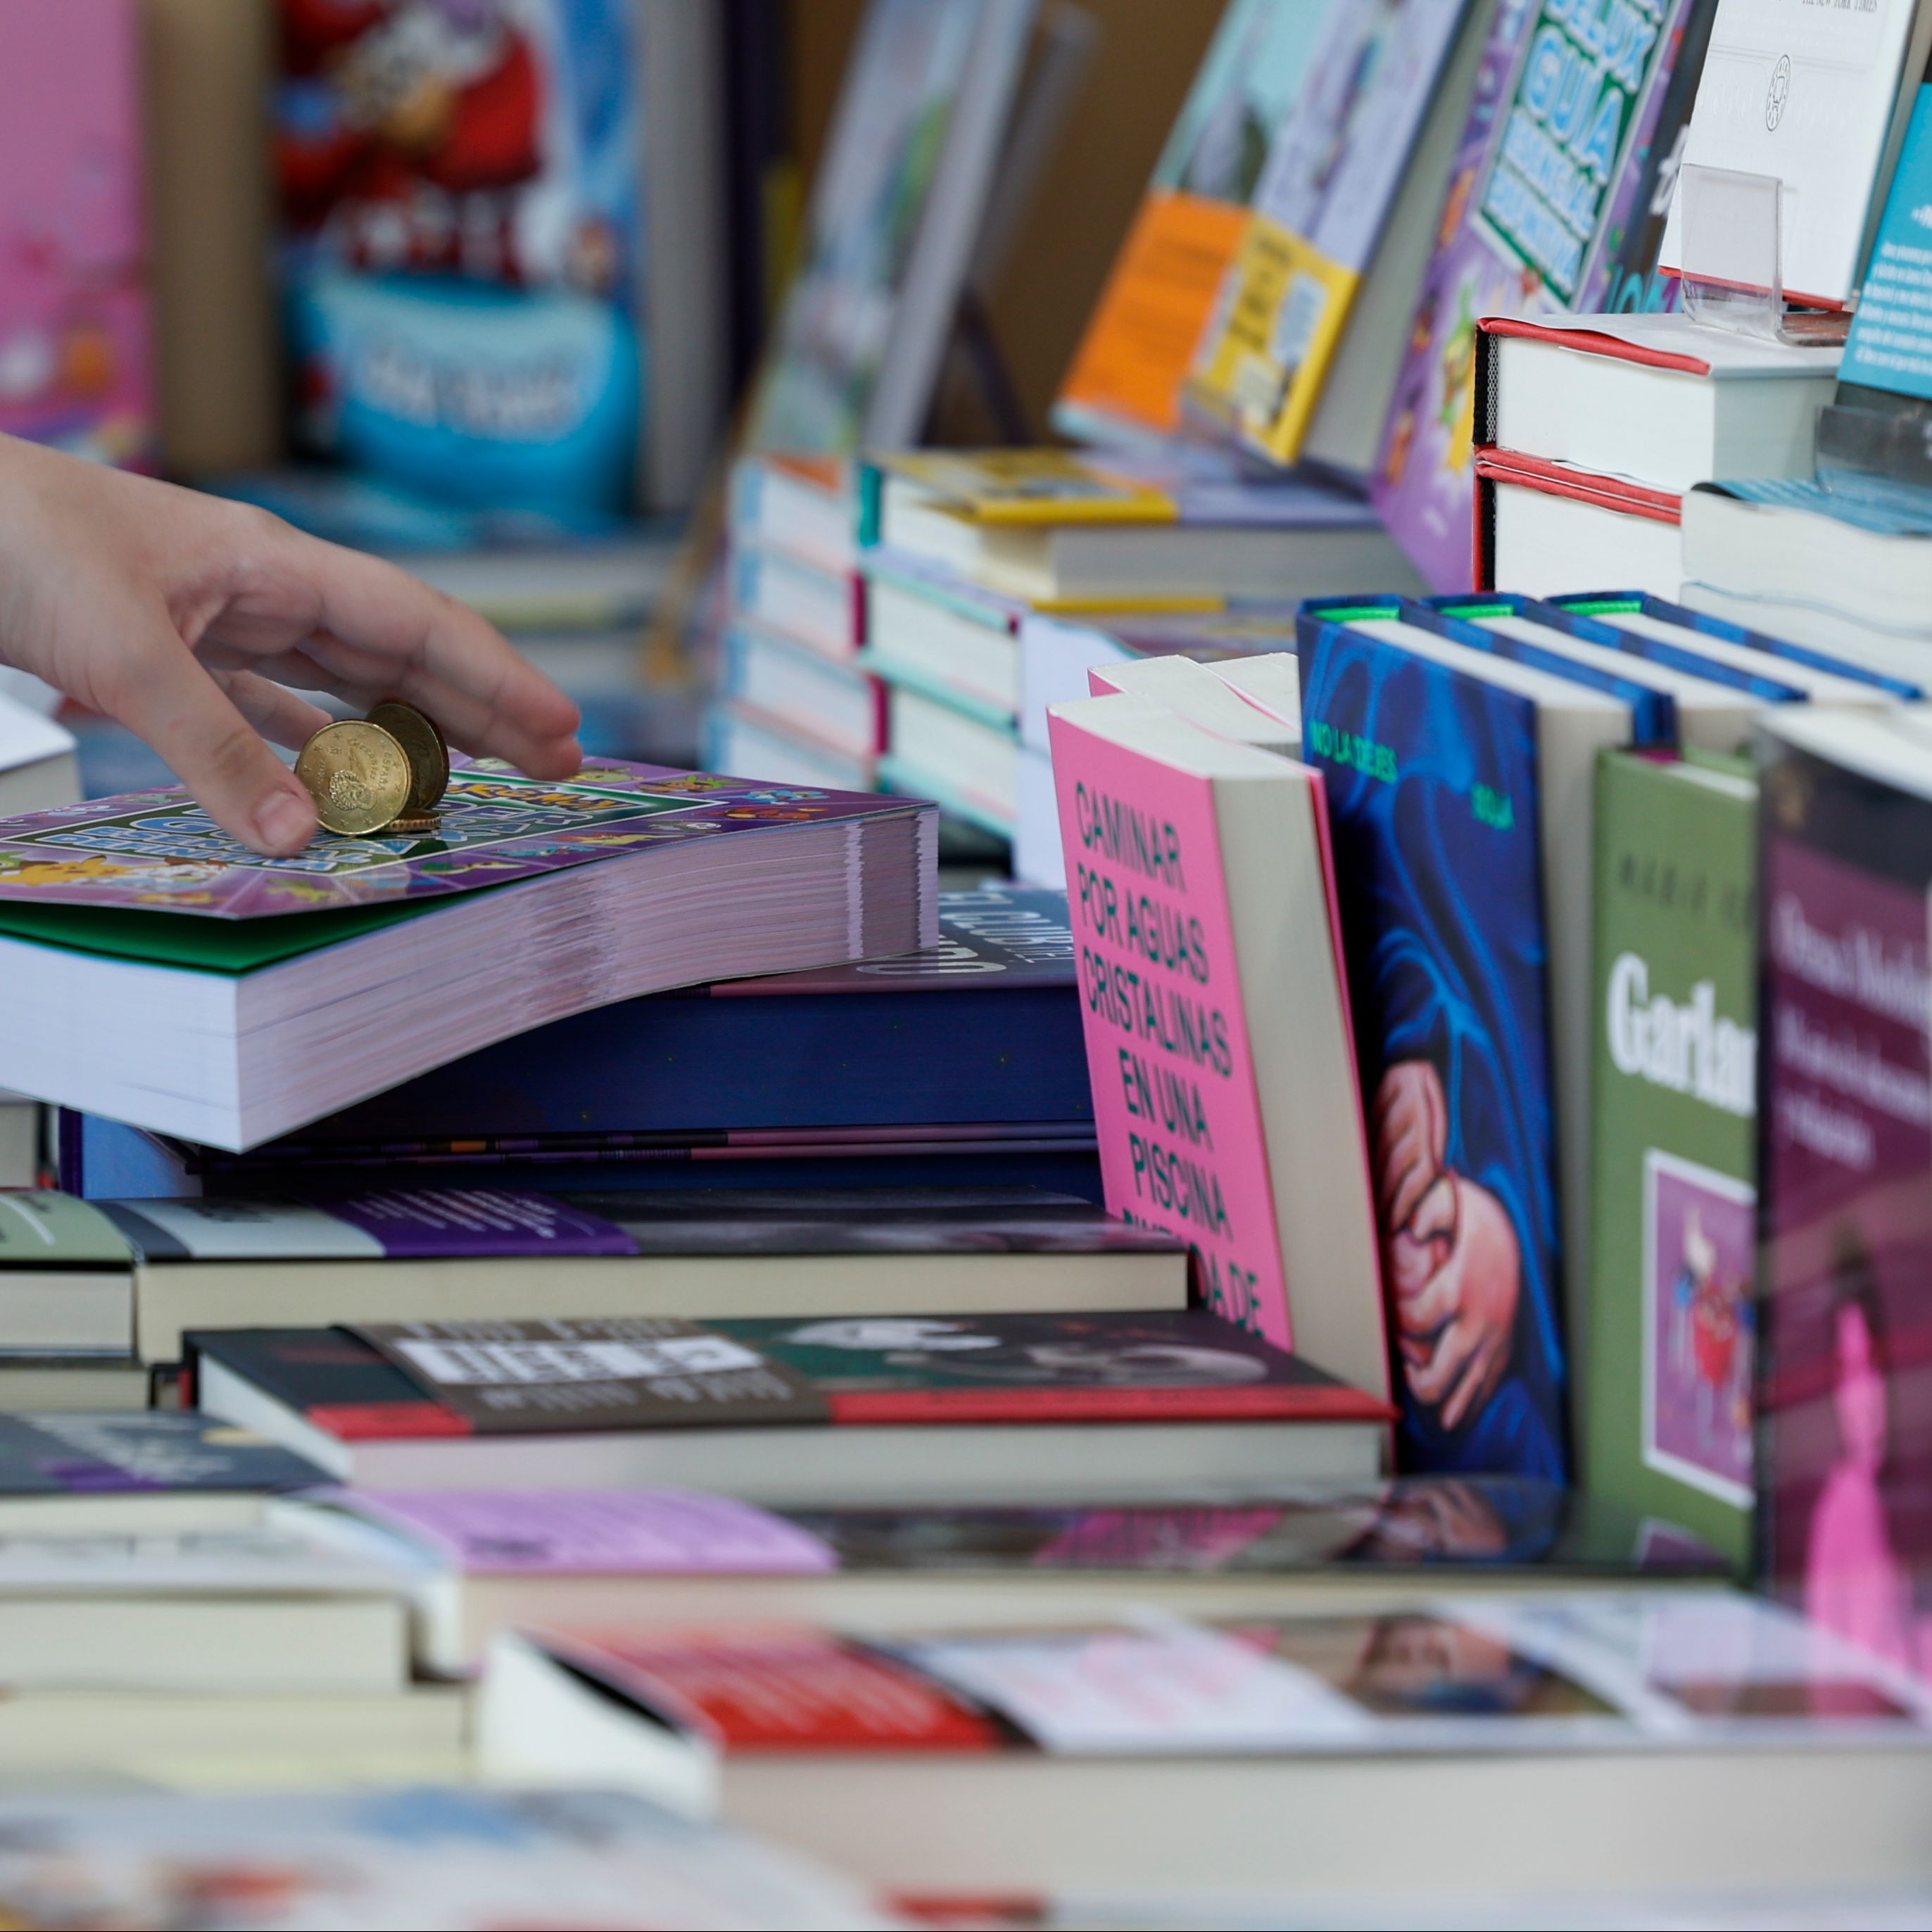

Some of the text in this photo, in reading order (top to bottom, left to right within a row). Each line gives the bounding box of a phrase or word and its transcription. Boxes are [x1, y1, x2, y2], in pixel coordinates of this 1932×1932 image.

[1075, 781, 1187, 893] CAMINAR
[1077, 861, 1209, 985] POR AGUAS
[1083, 945, 1232, 1079] CRISTALINAS
[1118, 1047, 1214, 1153] EN UNA
[1128, 1132, 1234, 1244] PISCINA
[1228, 1260, 1265, 1338] DE
